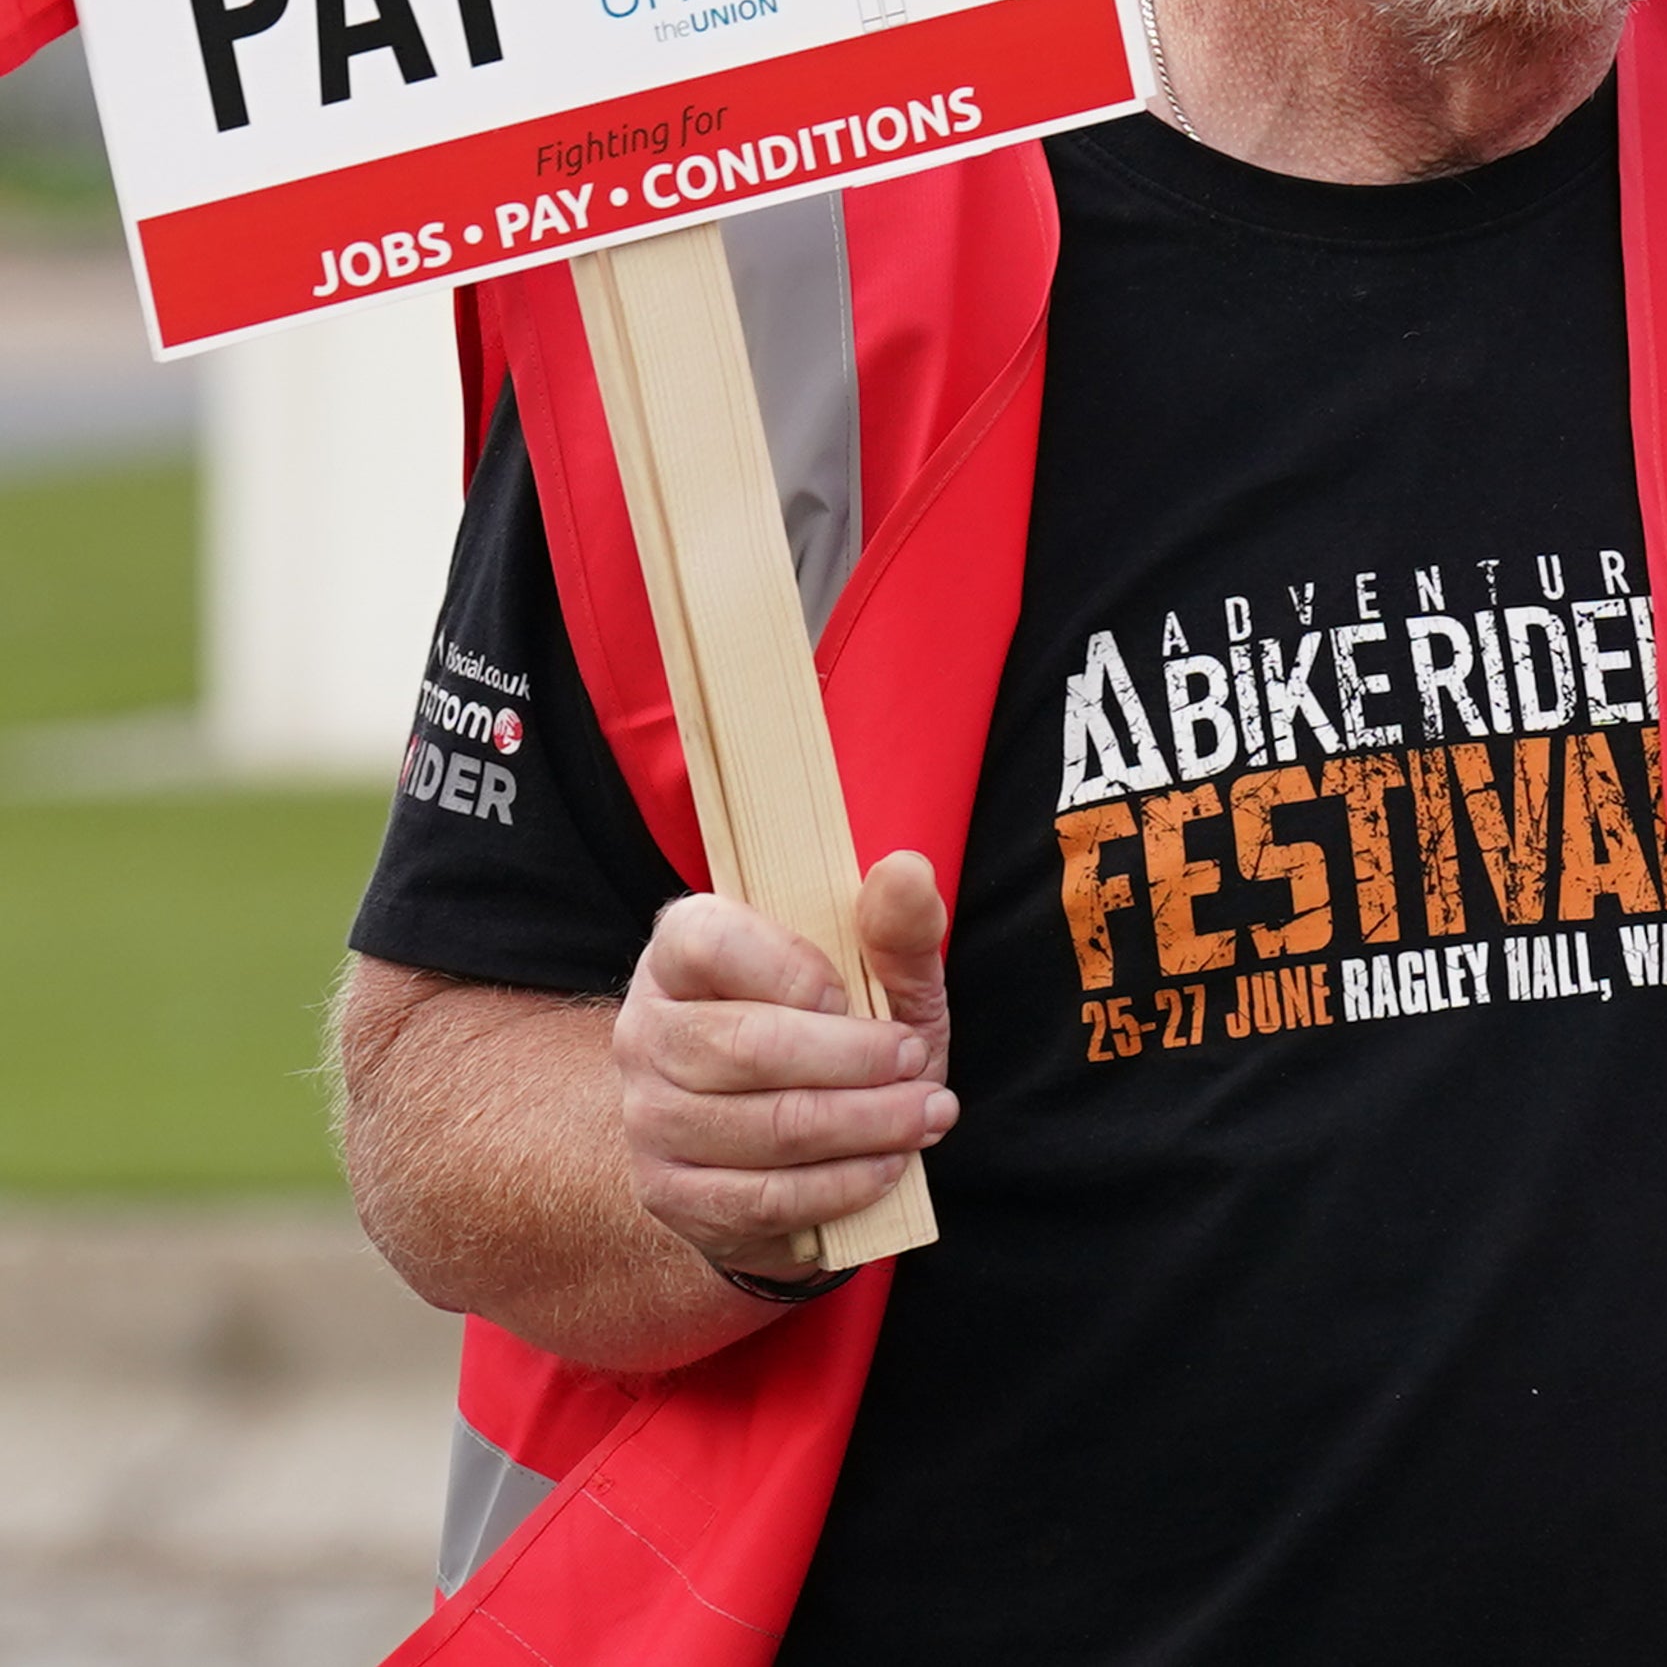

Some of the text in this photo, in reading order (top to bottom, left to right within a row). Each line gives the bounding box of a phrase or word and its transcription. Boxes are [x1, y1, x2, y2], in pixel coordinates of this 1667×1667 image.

[313, 86, 982, 297] JOBS PAY CONDITIONS
[535, 104, 729, 178] Fighting for
[404, 737, 515, 826] IDER
[1080, 983, 1206, 1063] 25-27
[1225, 963, 1335, 1039] JUNE
[1341, 941, 1491, 1023] RAGLEY
[1503, 931, 1613, 1002] HALL,
